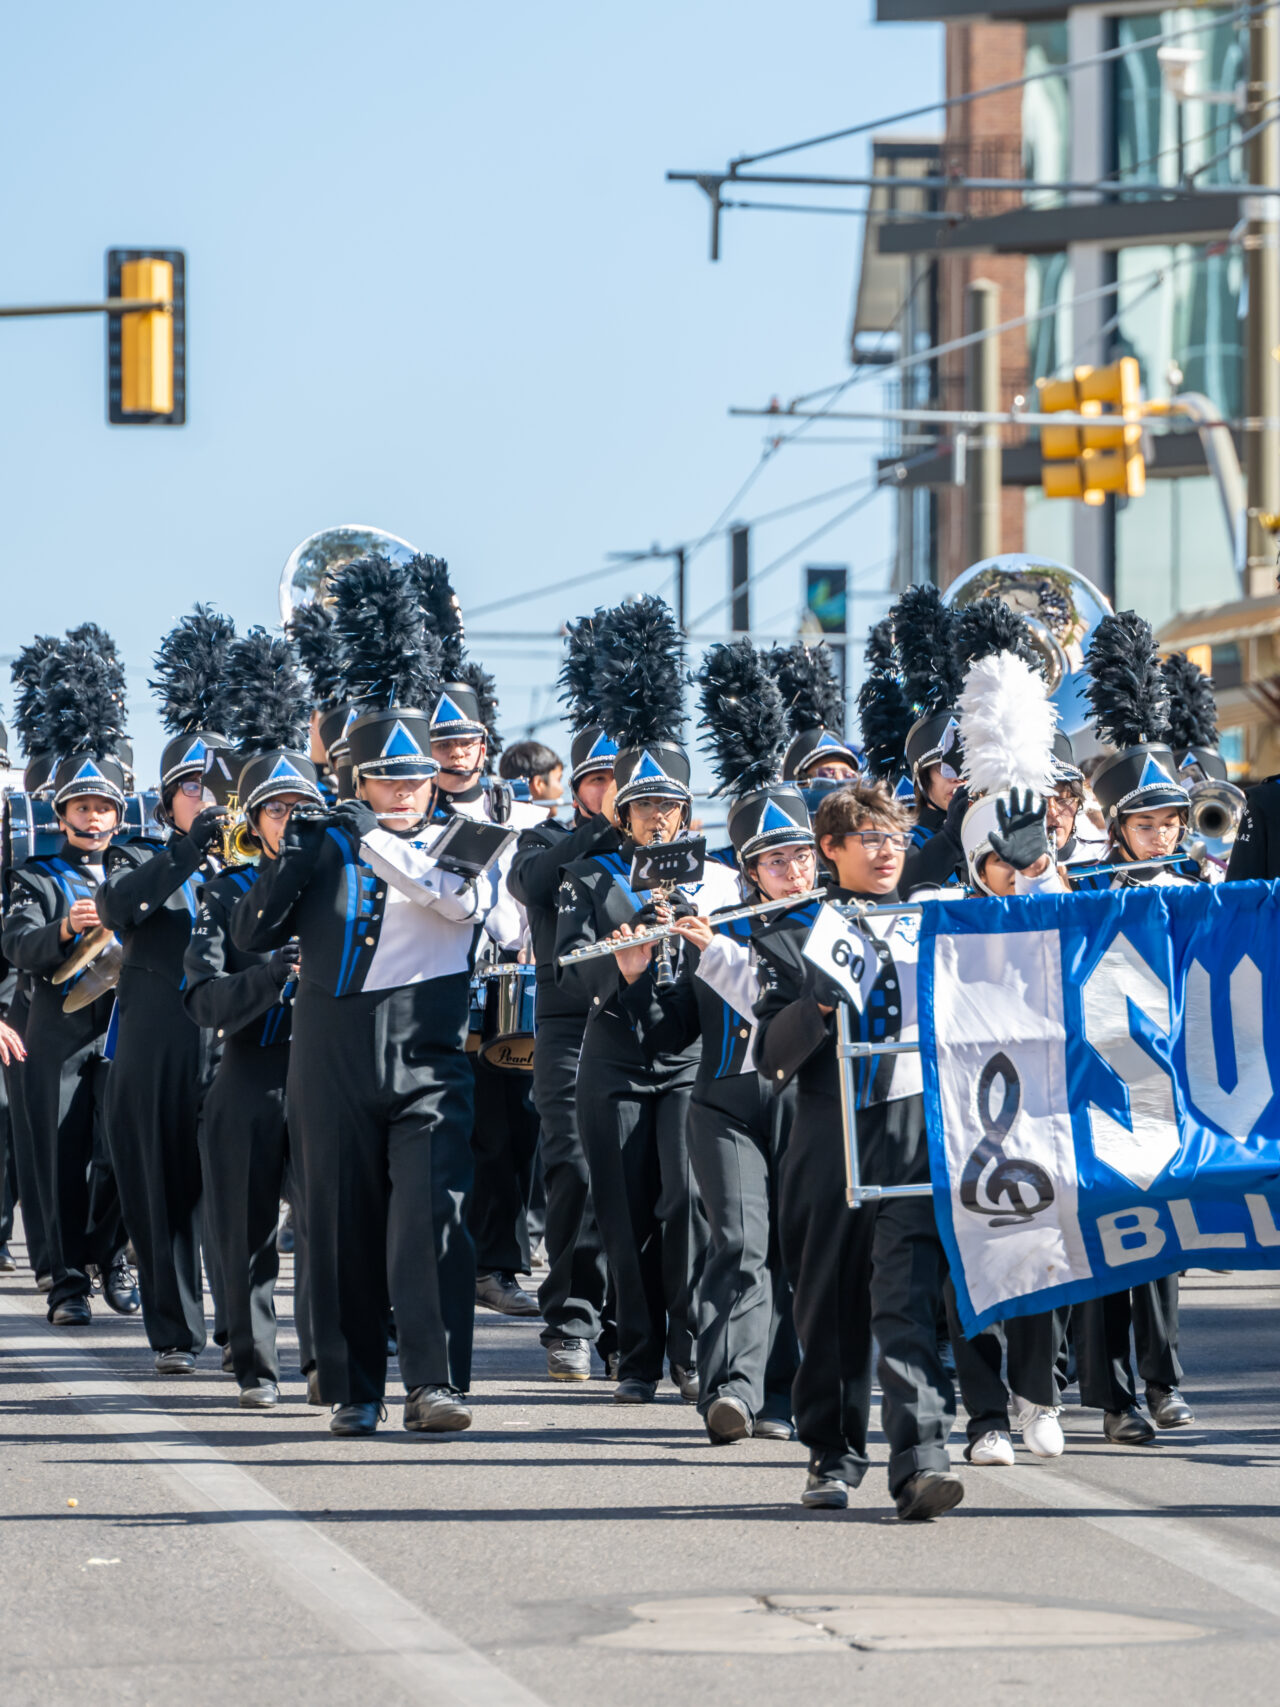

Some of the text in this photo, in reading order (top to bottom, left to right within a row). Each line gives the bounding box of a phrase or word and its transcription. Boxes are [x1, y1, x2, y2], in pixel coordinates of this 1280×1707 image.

[1240, 833, 1250, 842] AZ
[197, 927, 208, 935] AZ
[831, 938, 866, 984] 60
[496, 1046, 534, 1063] Pearl
